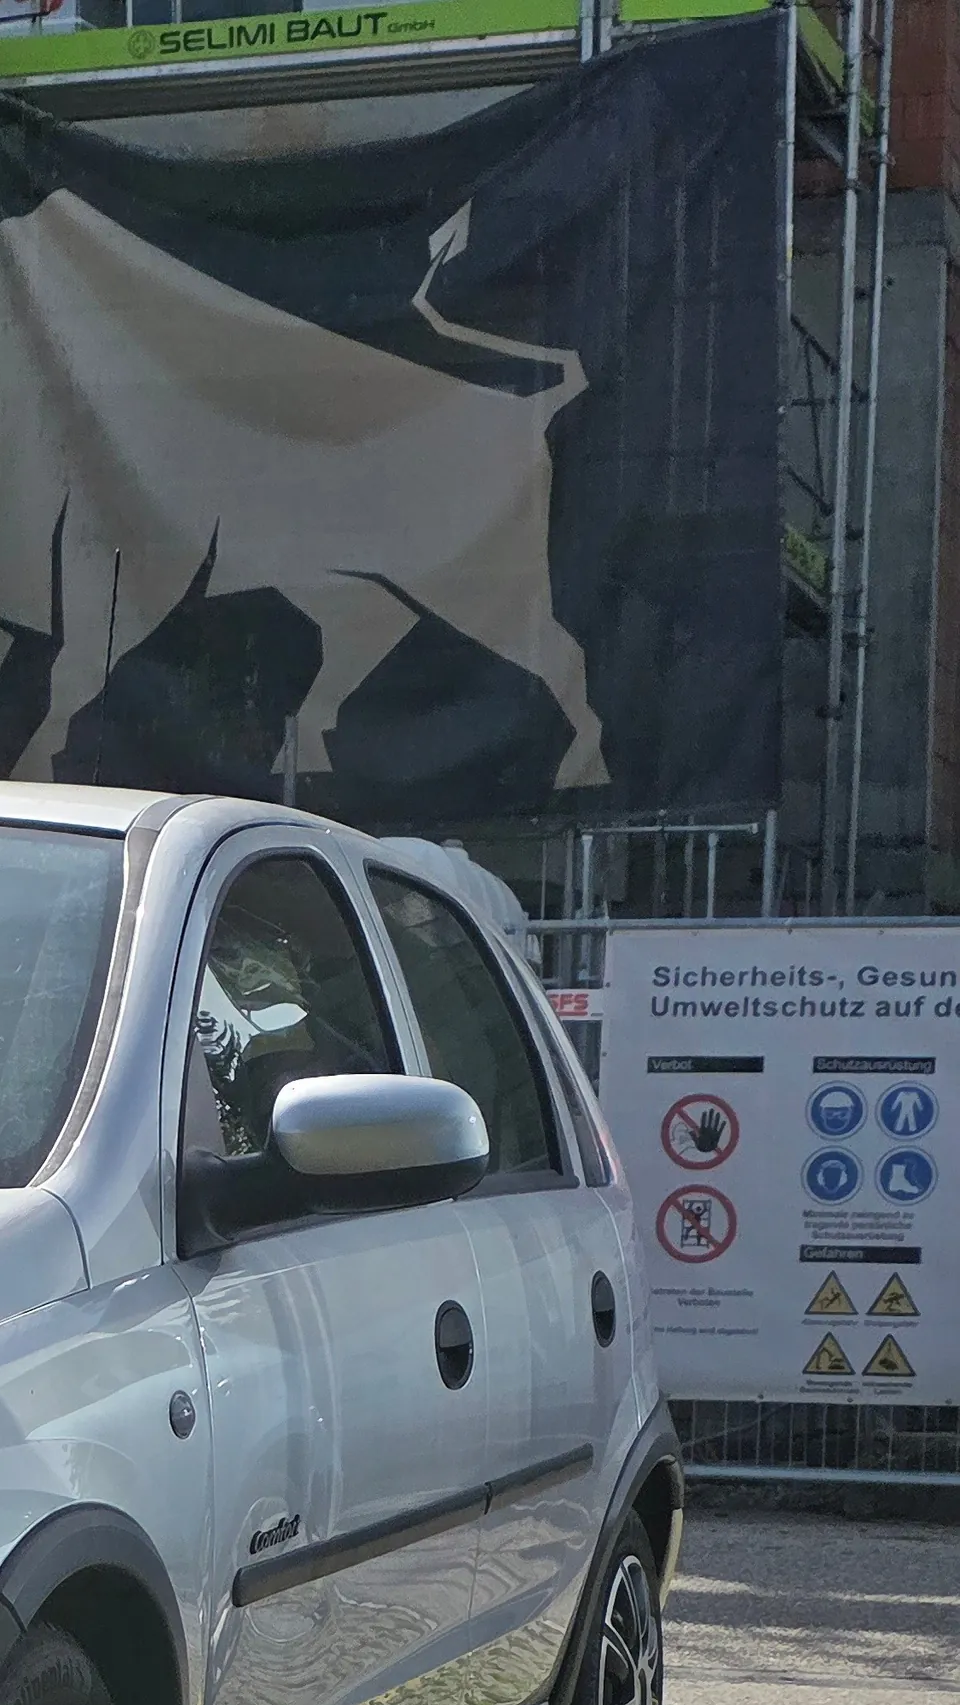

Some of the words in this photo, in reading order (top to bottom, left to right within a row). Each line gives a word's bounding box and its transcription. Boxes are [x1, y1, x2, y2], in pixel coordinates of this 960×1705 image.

[159, 22, 276, 55] SELIMI
[286, 11, 388, 43] BAUT
[651, 965, 845, 990] Sicherheits-,
[856, 965, 957, 987] Gesun
[650, 995, 866, 1018] Umweltschutz
[874, 995, 926, 1018] auf
[651, 1058, 693, 1071] Verbot
